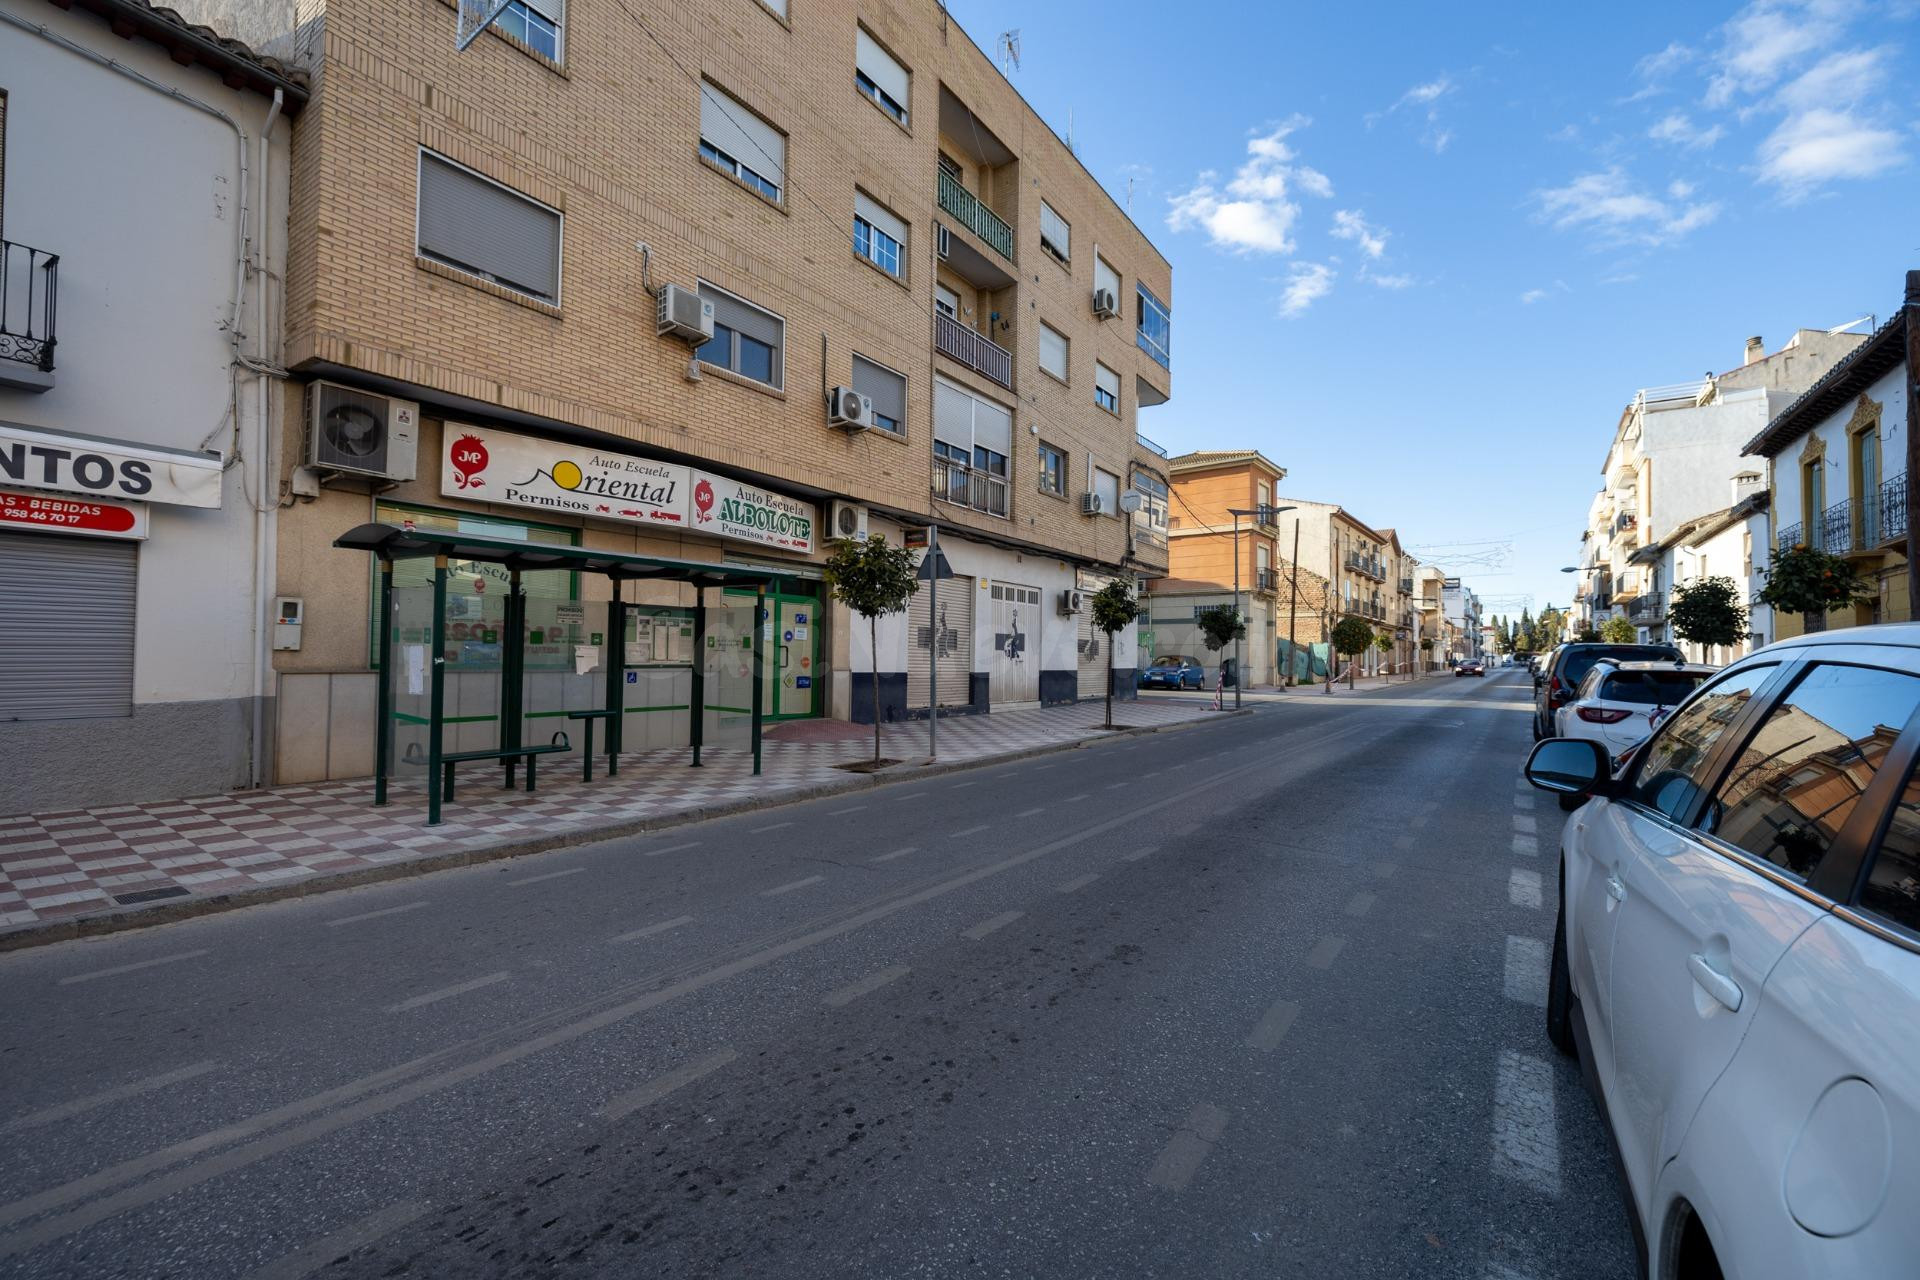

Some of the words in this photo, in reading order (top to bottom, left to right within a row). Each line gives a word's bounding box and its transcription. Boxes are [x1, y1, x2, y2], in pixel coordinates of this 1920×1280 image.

[589, 455, 622, 471] Auto
[625, 460, 670, 480] Escuela
[30, 500, 102, 516] BEBIDAS
[505, 488, 590, 512] Permisos
[736, 486, 763, 506] Auto
[765, 494, 805, 516] Escuela
[4, 508, 28, 518] 958
[30, 511, 47, 520] 46
[49, 513, 66, 522] 70
[68, 515, 81, 524] 17
[716, 498, 811, 540] ALBOLOTE
[722, 524, 763, 540] Permisos
